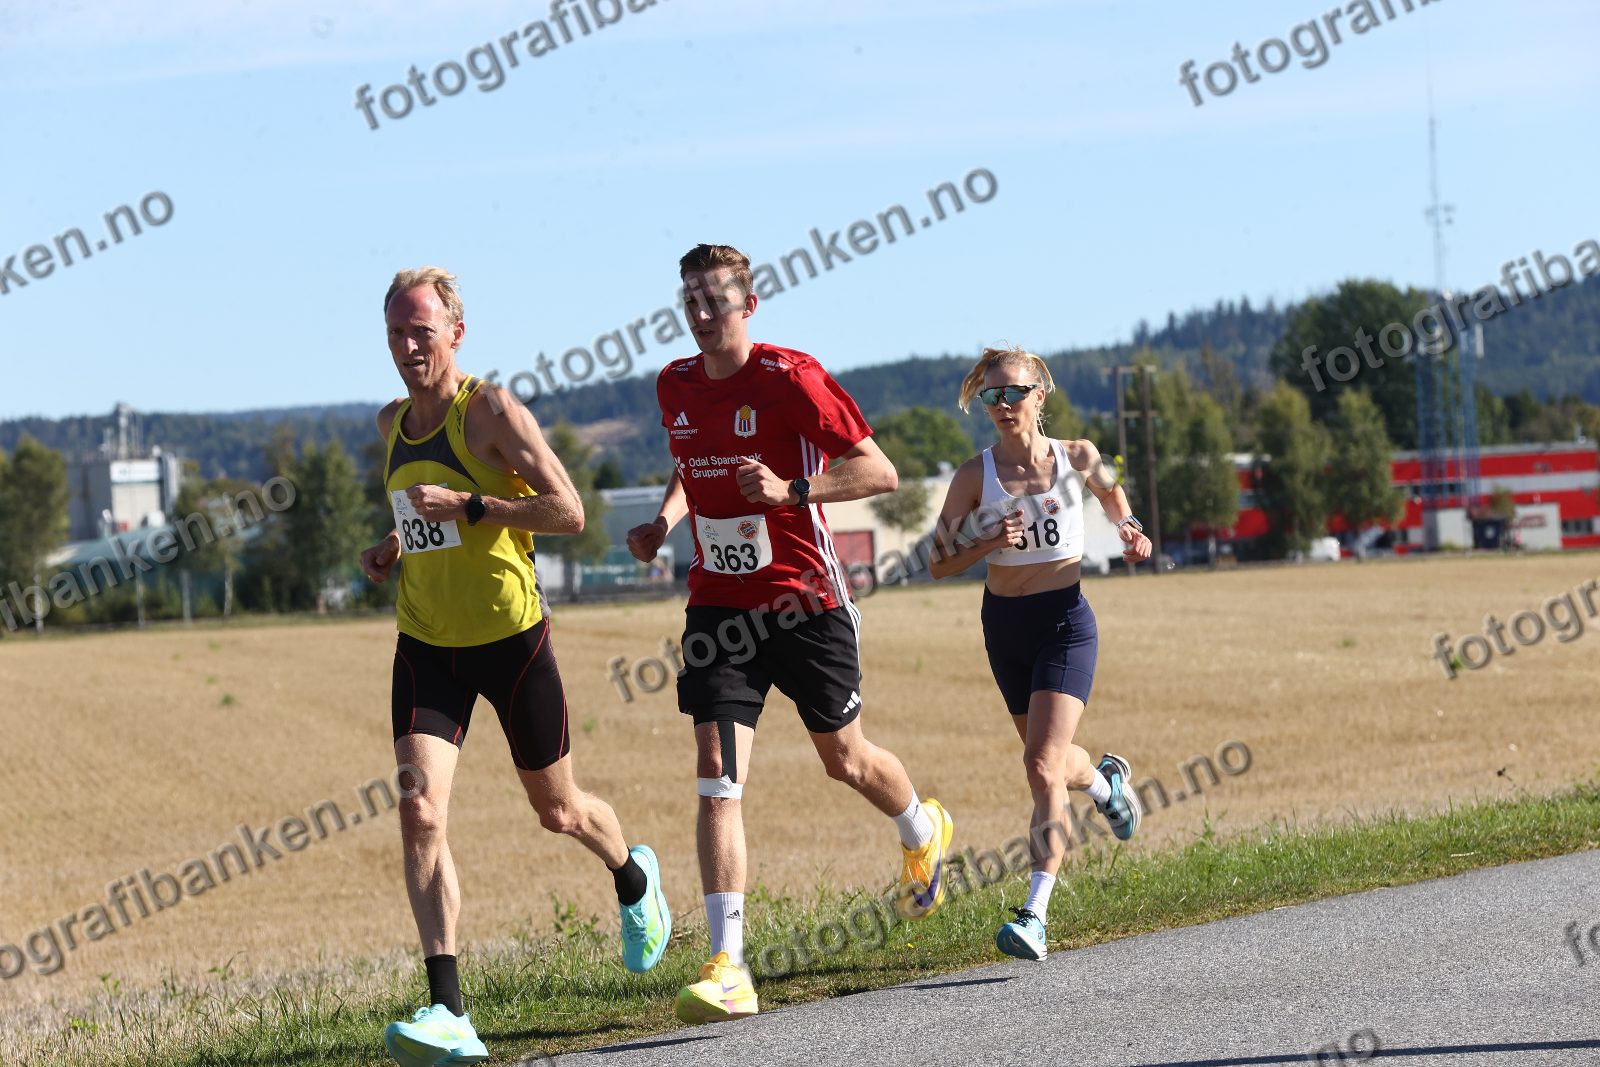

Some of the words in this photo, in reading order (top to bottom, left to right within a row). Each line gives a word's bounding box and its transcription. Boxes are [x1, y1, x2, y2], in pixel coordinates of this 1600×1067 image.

[688, 458, 709, 468] Odal
[710, 453, 762, 466] Sparebnk
[692, 468, 728, 479] Gruppen
[402, 518, 445, 550] 838
[710, 543, 759, 572] 363
